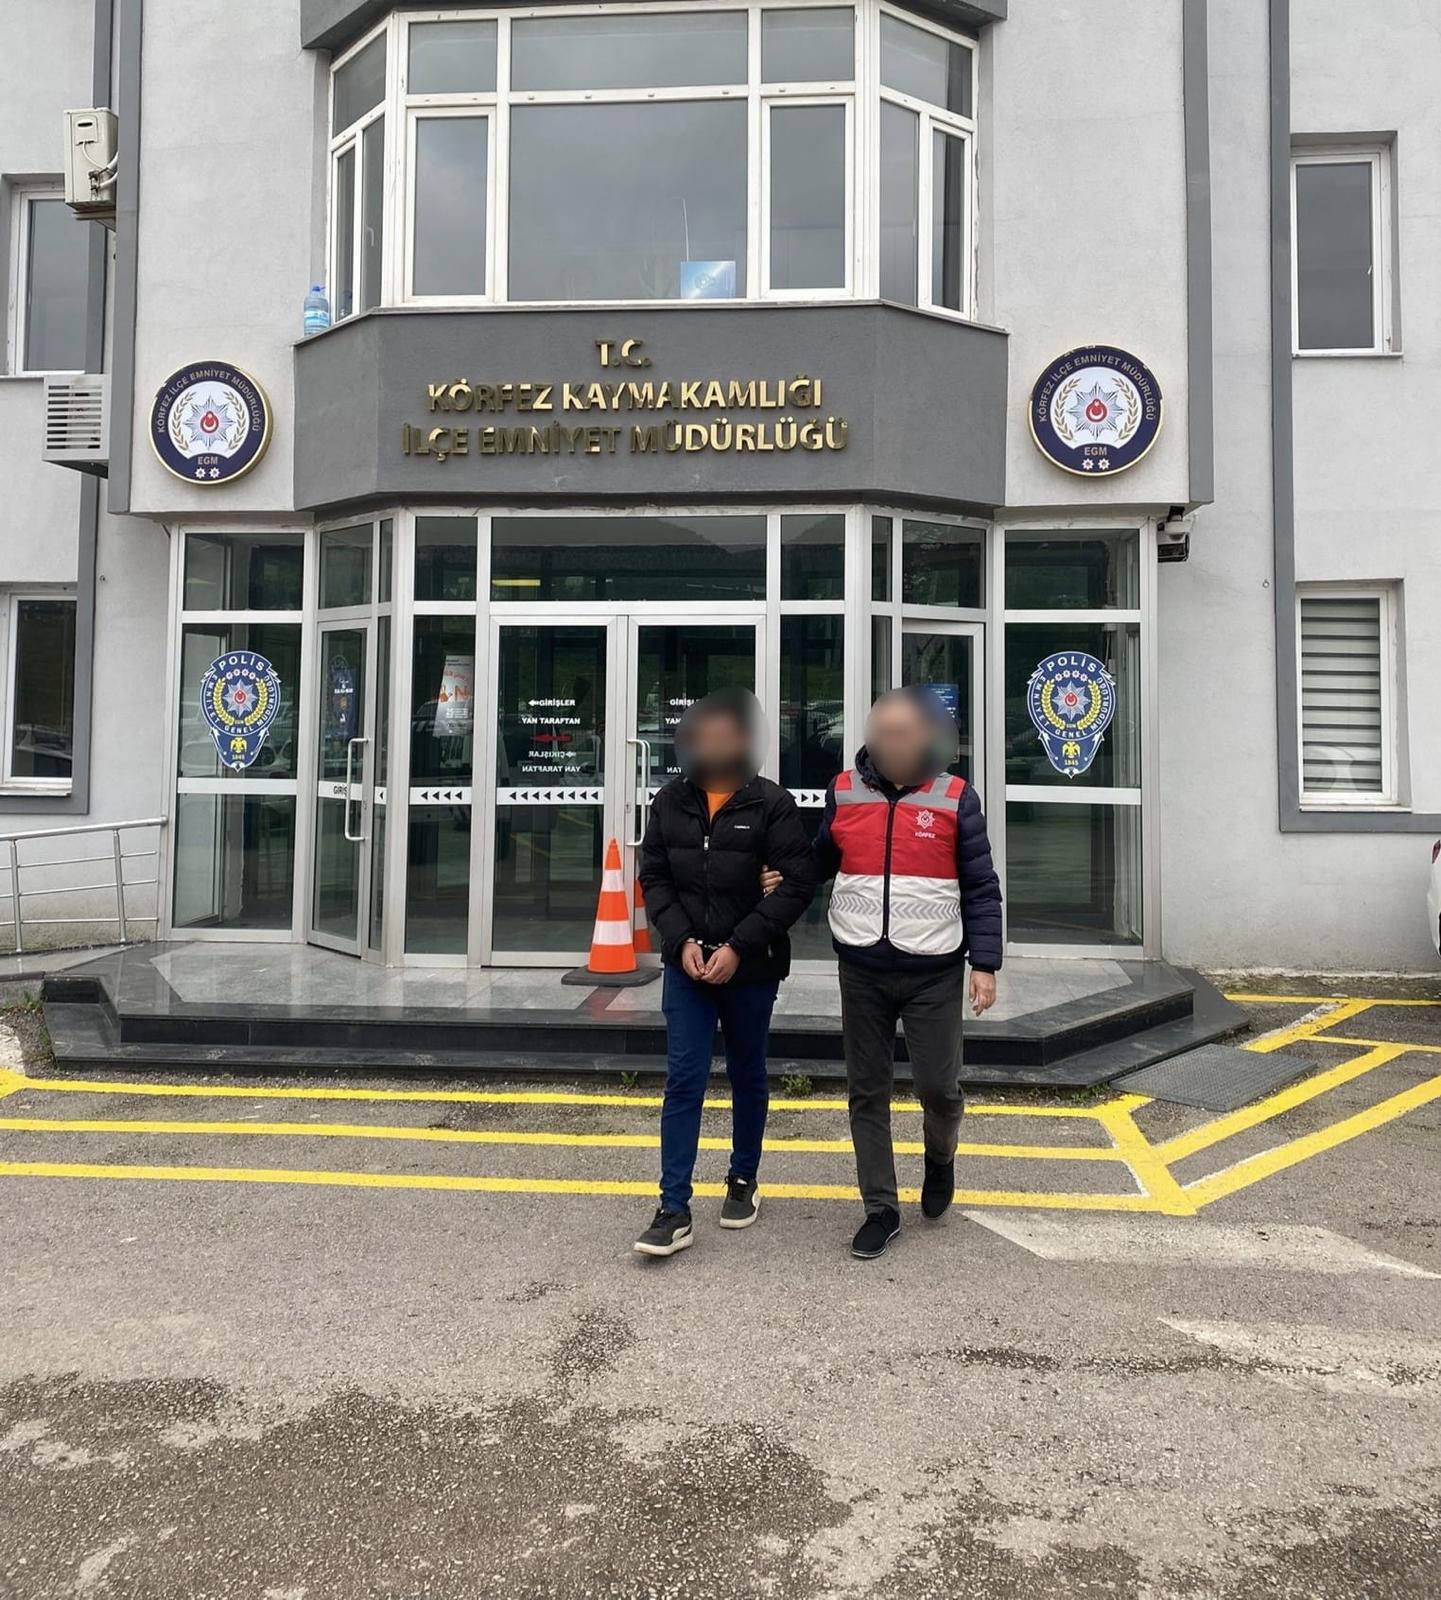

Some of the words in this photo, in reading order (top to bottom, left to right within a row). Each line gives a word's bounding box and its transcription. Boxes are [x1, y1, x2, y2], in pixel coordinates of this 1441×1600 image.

[595, 339, 650, 367] T.C.
[427, 377, 553, 412] KÖRFEZ
[562, 374, 822, 411] KAYMAKAMLIĞI
[1038, 381, 1054, 422] KÖRFEZ
[1051, 362, 1073, 382] İLÇE
[1074, 353, 1121, 366] EMNİYET
[1121, 362, 1156, 420] MÜDÜRLÜĞÜ
[157, 394, 173, 433] KÖRFEZ
[168, 376, 190, 395] İLÇE
[189, 369, 231, 381] EMNİYET
[402, 421, 469, 462] İLÇE
[479, 420, 621, 454] EMNİYET
[630, 417, 848, 453] MÜDÜRLÜĞÜ
[197, 456, 219, 465] EGM
[1084, 447, 1107, 456] EGM
[218, 655, 265, 671] POLİS
[1046, 656, 1097, 672] POLİS
[540, 698, 576, 707] GİRİŞLER
